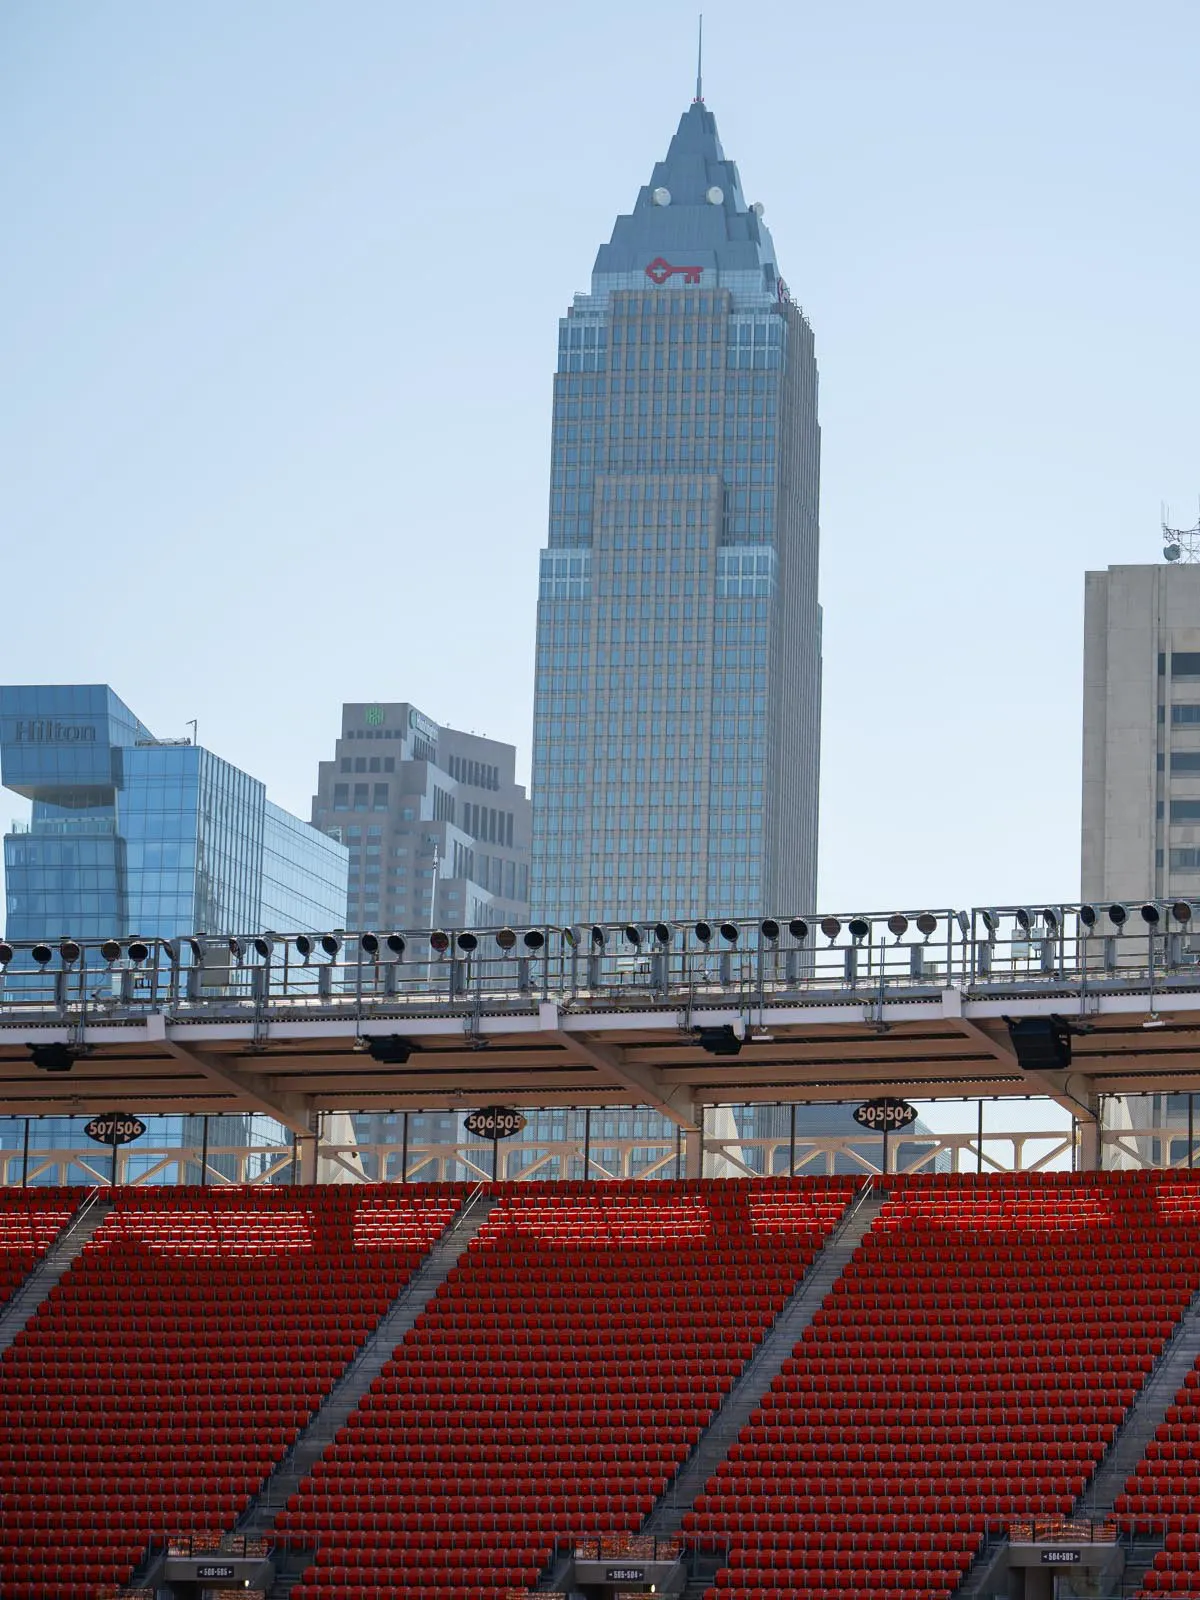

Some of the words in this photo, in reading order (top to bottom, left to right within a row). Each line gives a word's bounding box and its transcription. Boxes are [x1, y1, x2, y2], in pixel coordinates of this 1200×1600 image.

[15, 720, 97, 742] Hilton
[858, 1106, 885, 1121] 505
[886, 1106, 913, 1120] 504
[89, 1121, 114, 1135] 507
[116, 1121, 142, 1135] 506
[468, 1115, 494, 1129] 506
[496, 1115, 521, 1129] 505
